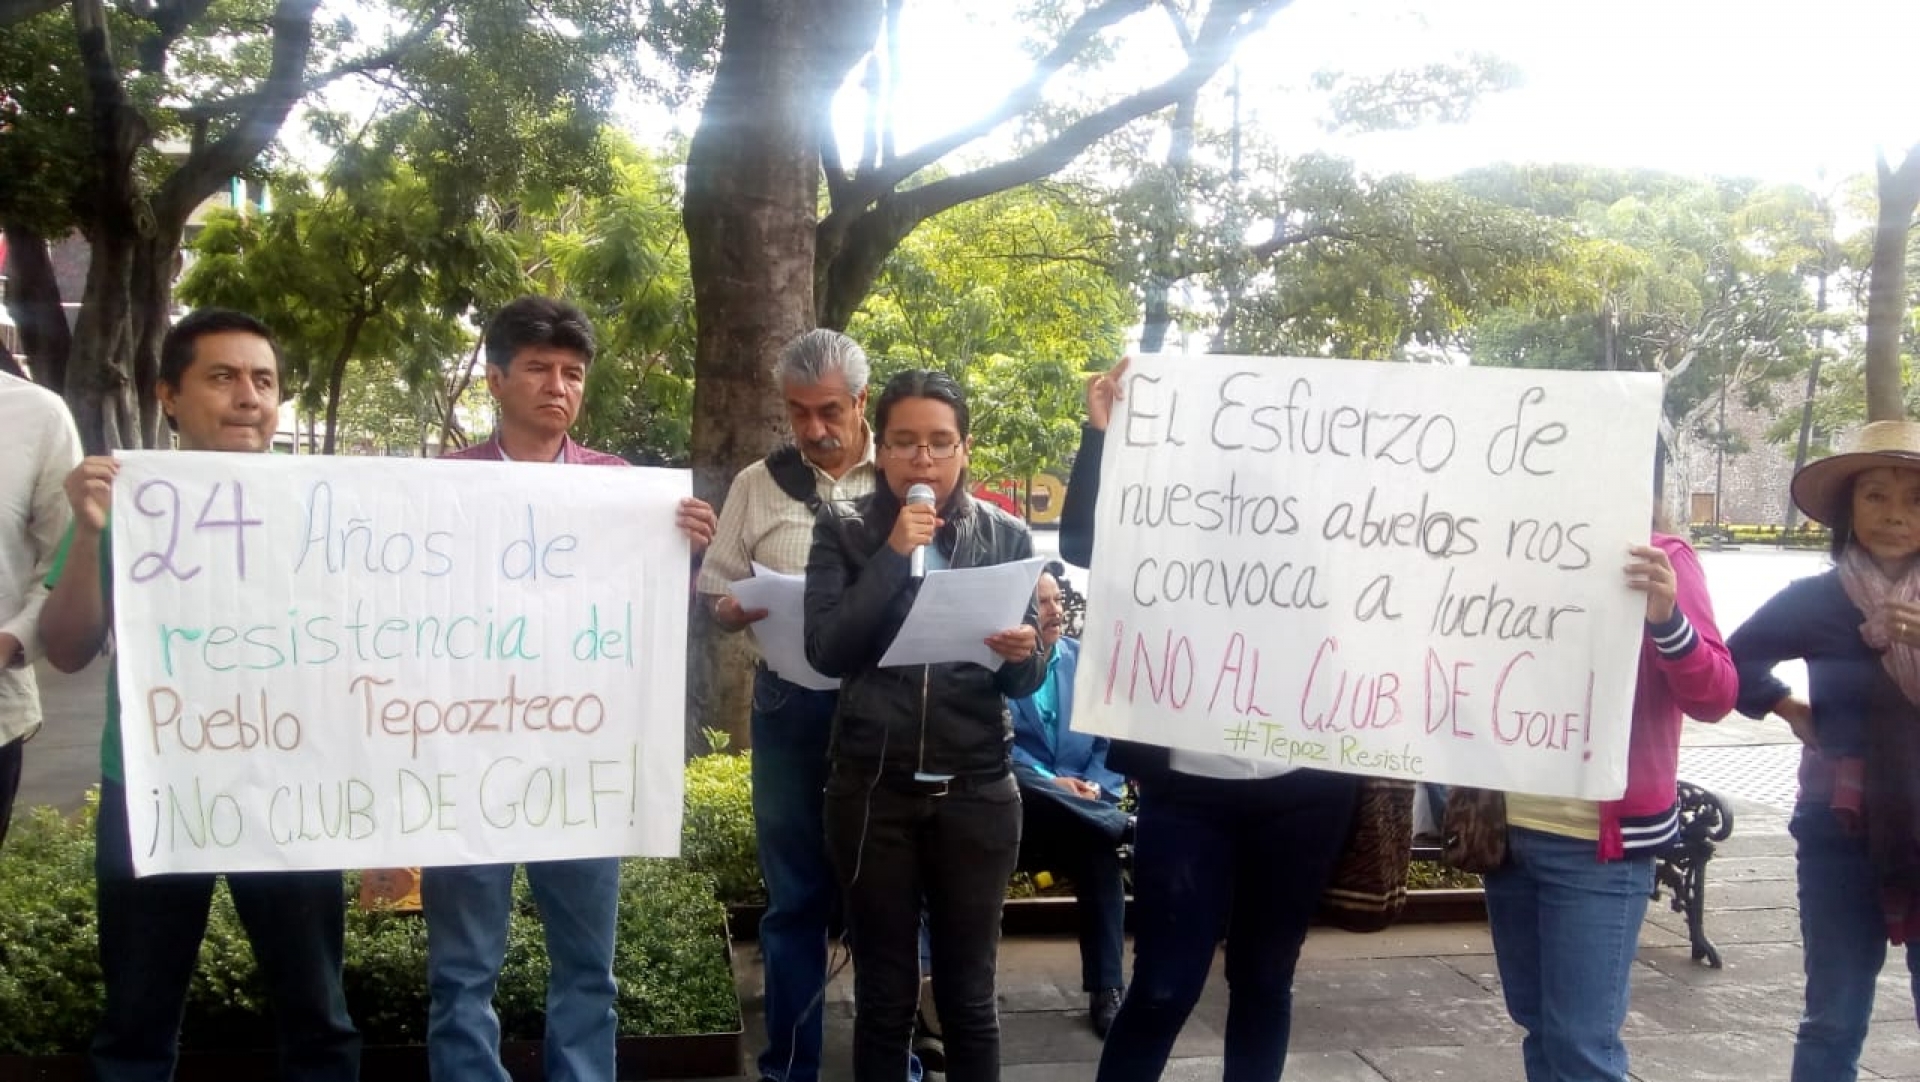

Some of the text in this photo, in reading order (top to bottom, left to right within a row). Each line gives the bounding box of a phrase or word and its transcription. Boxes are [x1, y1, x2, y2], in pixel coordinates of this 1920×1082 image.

[1211, 372, 1457, 474] Esfuerzo
[1487, 386, 1570, 475] de
[130, 479, 580, 583] 24 Años de
[1118, 471, 1300, 535] nuestros
[1506, 522, 1592, 571] nos
[158, 600, 635, 676] resistencia del
[1133, 557, 1586, 641] convoca a luchar
[147, 674, 606, 759] Pueblo Tepozteco
[1207, 632, 1271, 717] AL
[1299, 635, 1403, 733] CLUB
[1423, 647, 1476, 739] DE
[1493, 650, 1596, 763] GOLF!
[269, 777, 377, 843] CLUB
[398, 768, 458, 835] DE
[479, 744, 639, 829] GOLF!
[1339, 736, 1427, 775] Resiste
